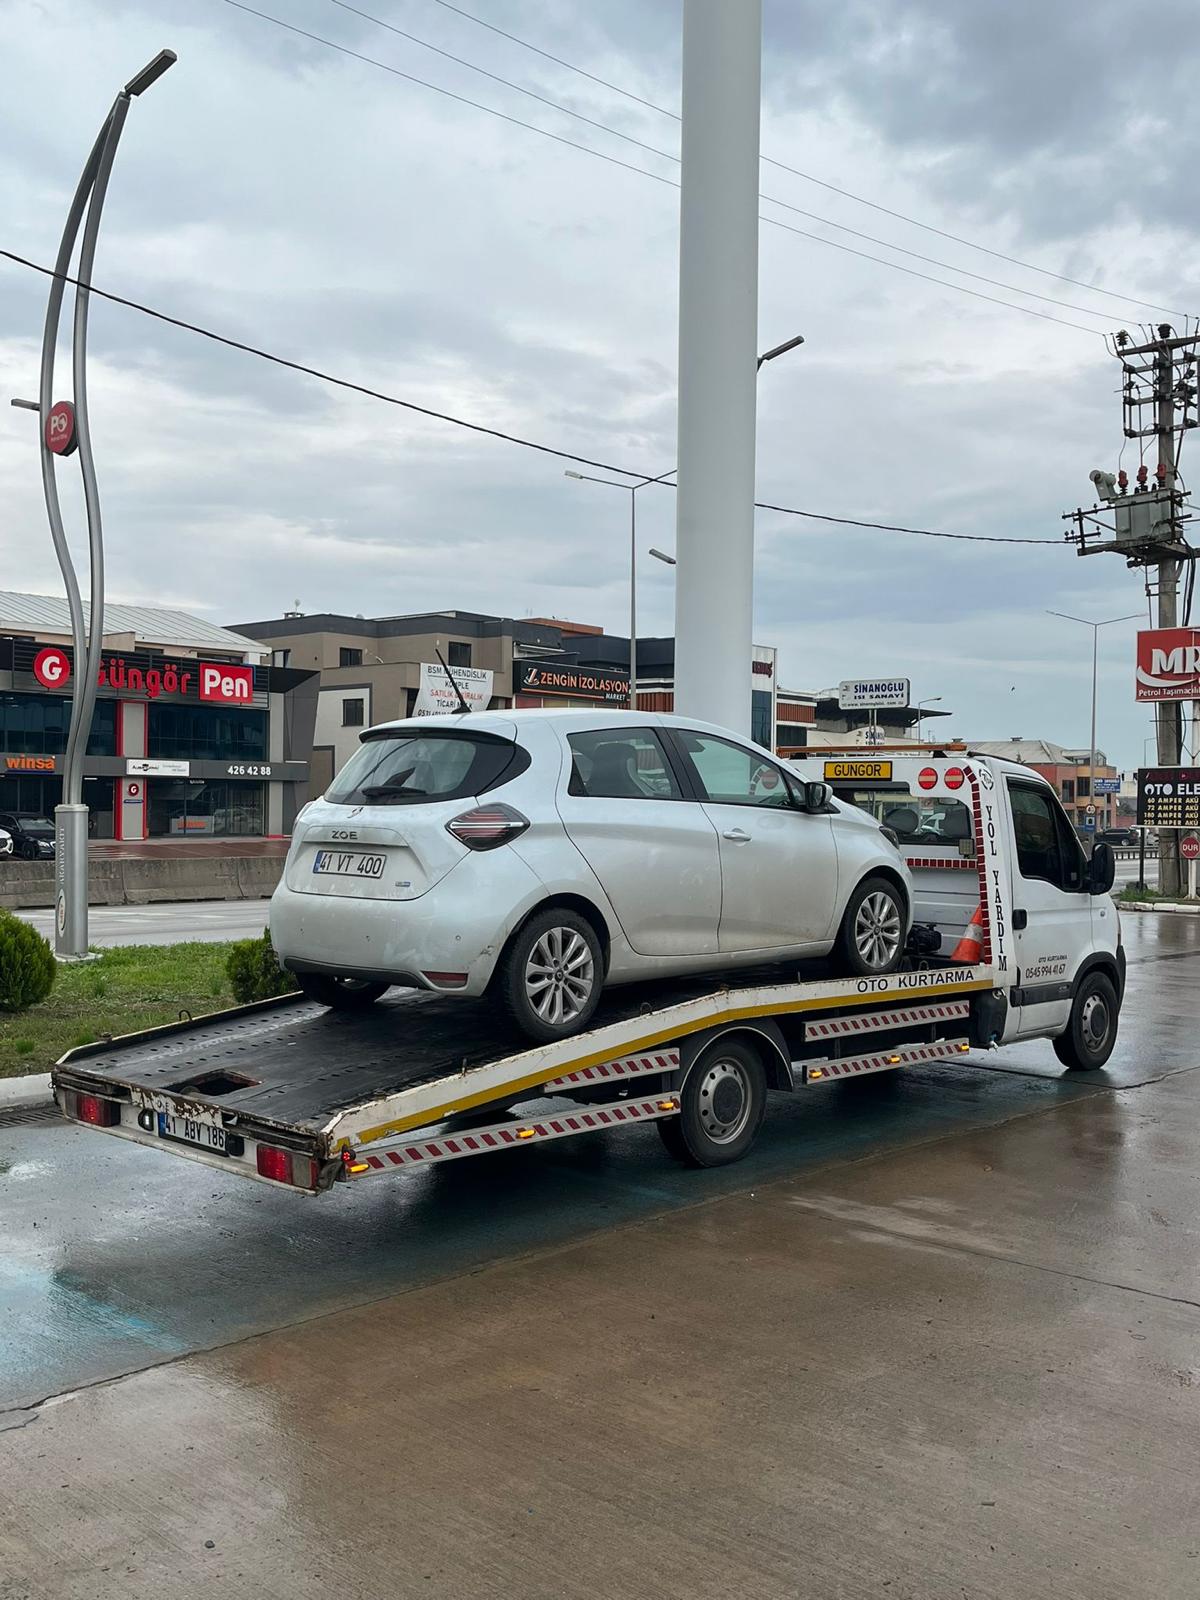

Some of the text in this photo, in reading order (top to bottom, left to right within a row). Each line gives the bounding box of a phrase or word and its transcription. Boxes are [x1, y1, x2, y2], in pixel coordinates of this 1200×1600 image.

[42, 655, 62, 680] G
[428, 666, 442, 674] BSM
[97, 658, 191, 698] üngör
[204, 668, 248, 698] Pen
[540, 672, 628, 692] ZENGİN İZOLASYON
[605, 693, 626, 701] MARKET
[6, 754, 54, 769] winsa
[227, 765, 272, 776] 426 42 88
[834, 764, 882, 777] GUNGOR
[1144, 784, 1173, 795] OTO
[332, 830, 358, 840] ZOE
[1182, 844, 1199, 852] DUR
[320, 853, 382, 875] 41 VT 400
[985, 805, 1008, 972] YOL YARDIM
[857, 969, 974, 993] OTO KURTARMA
[166, 1113, 176, 1134] 41
[207, 1126, 225, 1149] 186
